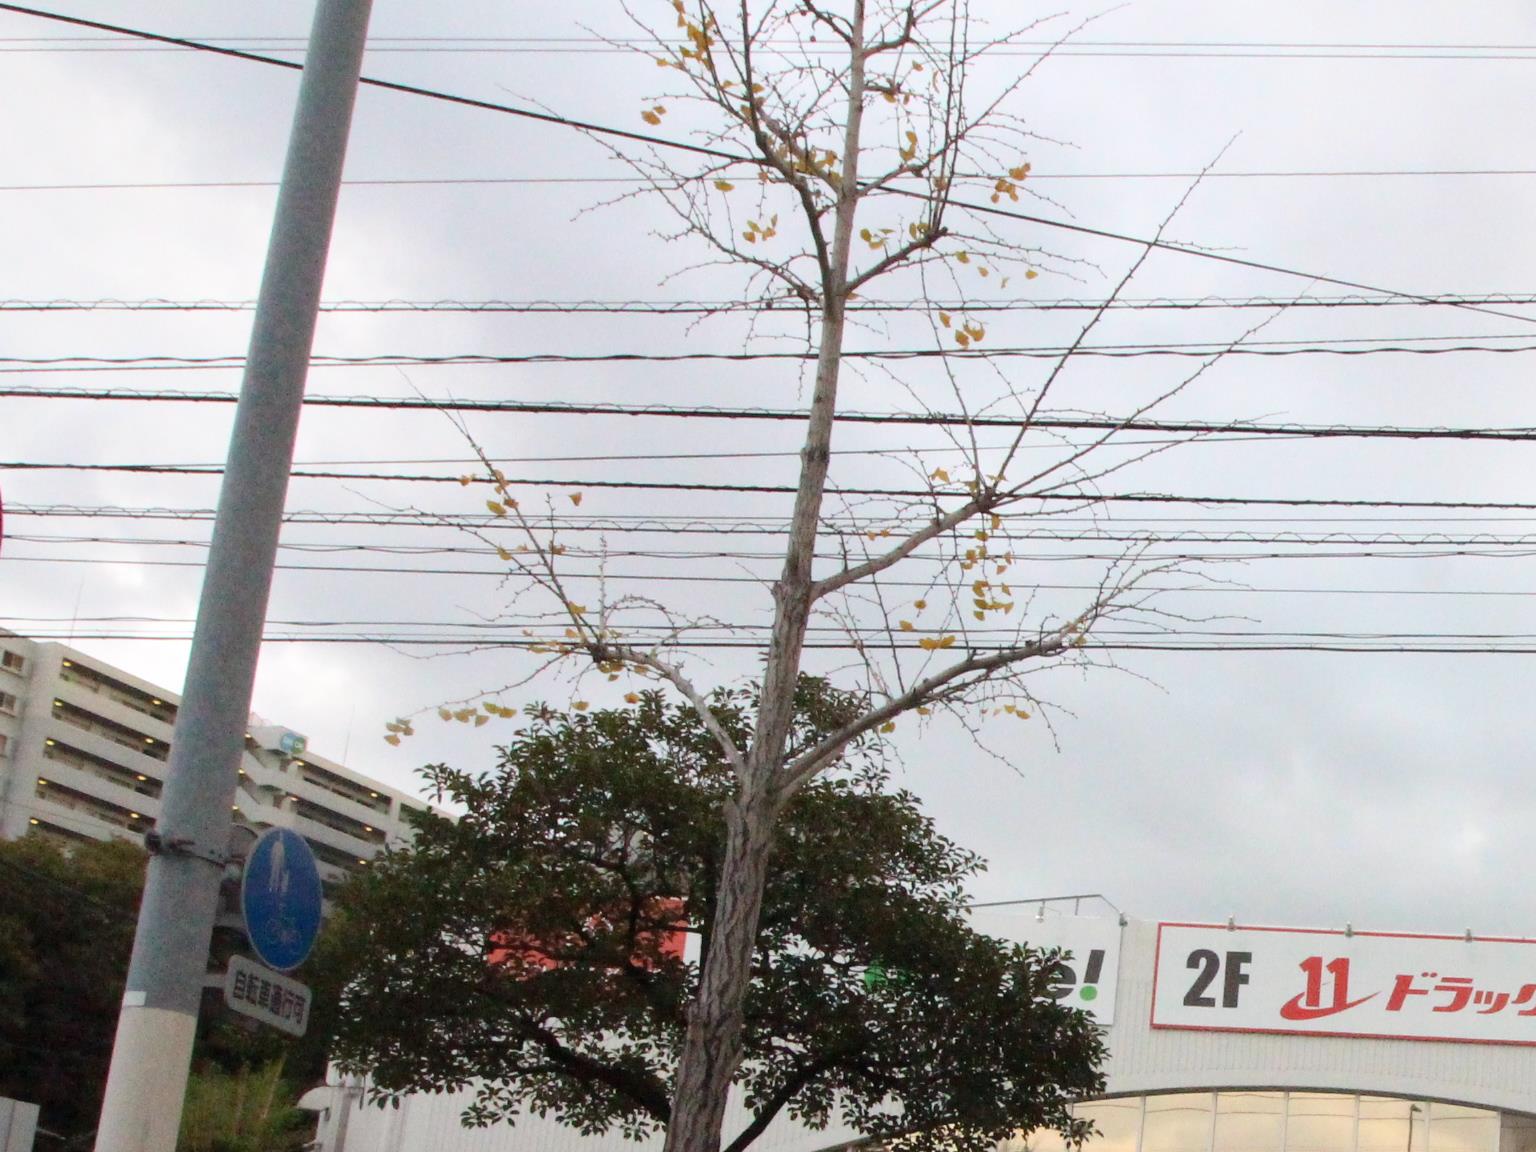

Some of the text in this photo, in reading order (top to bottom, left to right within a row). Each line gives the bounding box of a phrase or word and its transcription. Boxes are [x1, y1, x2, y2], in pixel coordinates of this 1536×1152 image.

[233, 970, 306, 1025] 自転車通行可
[1182, 948, 1252, 1008] 2F
